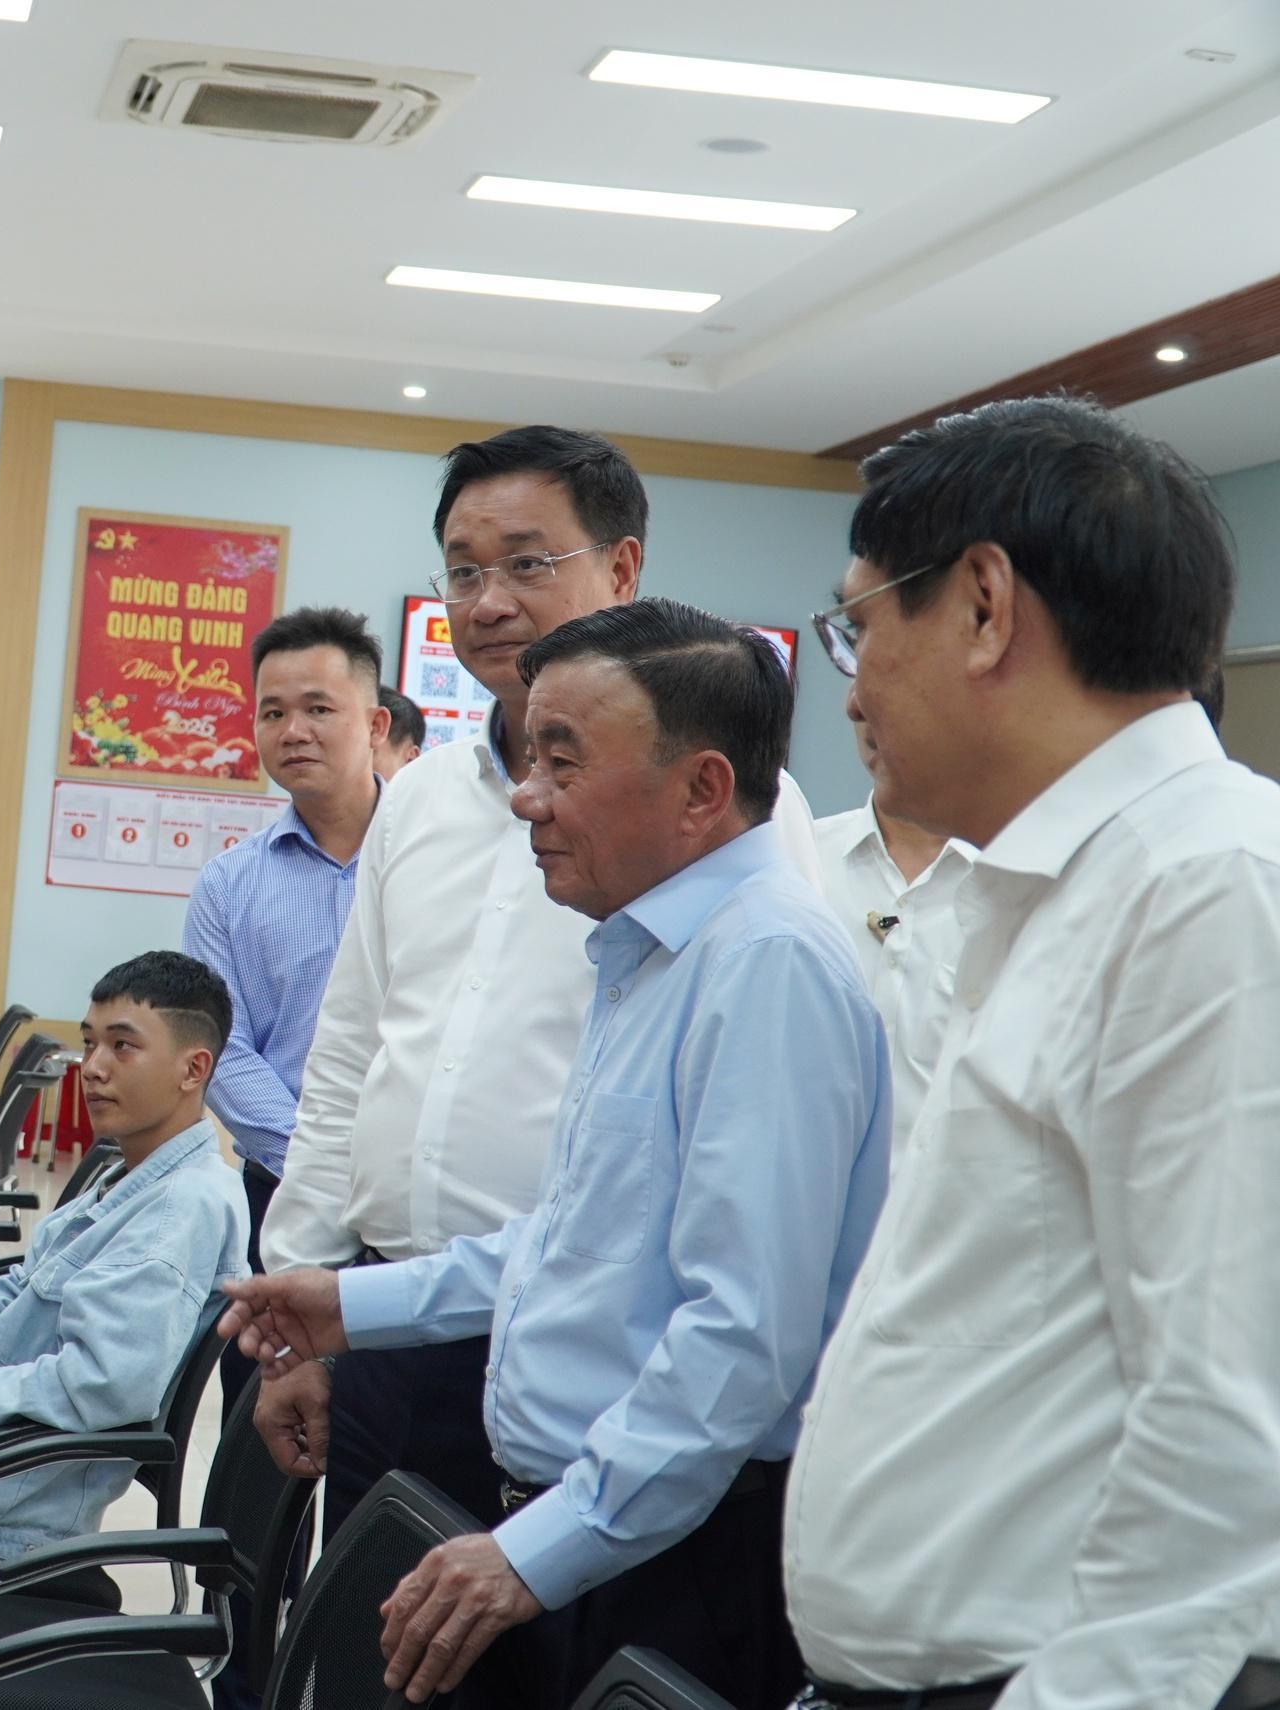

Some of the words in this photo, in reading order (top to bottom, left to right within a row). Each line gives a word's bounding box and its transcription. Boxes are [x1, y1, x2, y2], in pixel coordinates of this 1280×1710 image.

[109, 573, 179, 608] MỪNG
[186, 577, 248, 614] ĐẢNG
[106, 610, 183, 643] QUANG
[189, 618, 244, 649] VINH
[162, 709, 218, 740] 2026
